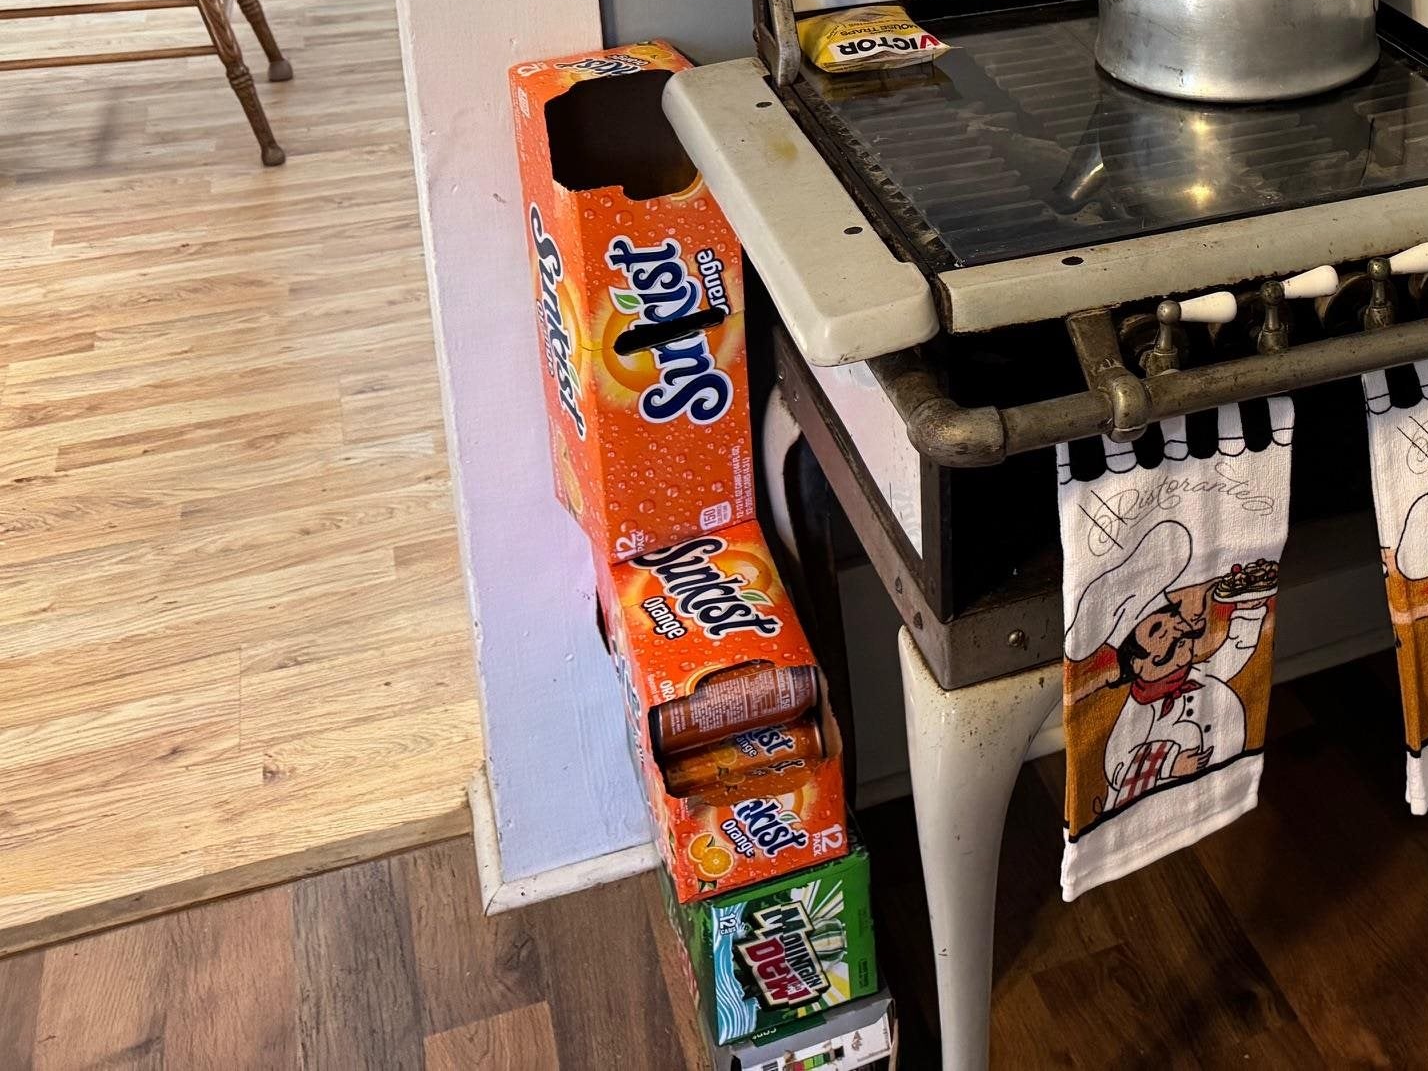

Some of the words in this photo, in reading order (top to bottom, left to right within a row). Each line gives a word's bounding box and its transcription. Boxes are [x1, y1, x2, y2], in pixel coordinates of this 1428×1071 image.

[838, 34, 940, 55] VICTOR
[696, 250, 729, 315] range
[530, 204, 585, 439] Sunkist
[703, 509, 717, 526] 150
[1088, 462, 1274, 556] Ristorante
[616, 531, 639, 559] 12
[636, 529, 646, 552] PACK
[630, 537, 782, 638] Sunkist
[643, 596, 687, 638] Orange
[660, 680, 677, 702] ORA
[735, 735, 758, 757] ange
[722, 820, 755, 857] Orange
[732, 799, 808, 857] nkist
[823, 823, 842, 853] 12
[813, 833, 823, 856] PACK
[719, 913, 736, 929] 12
